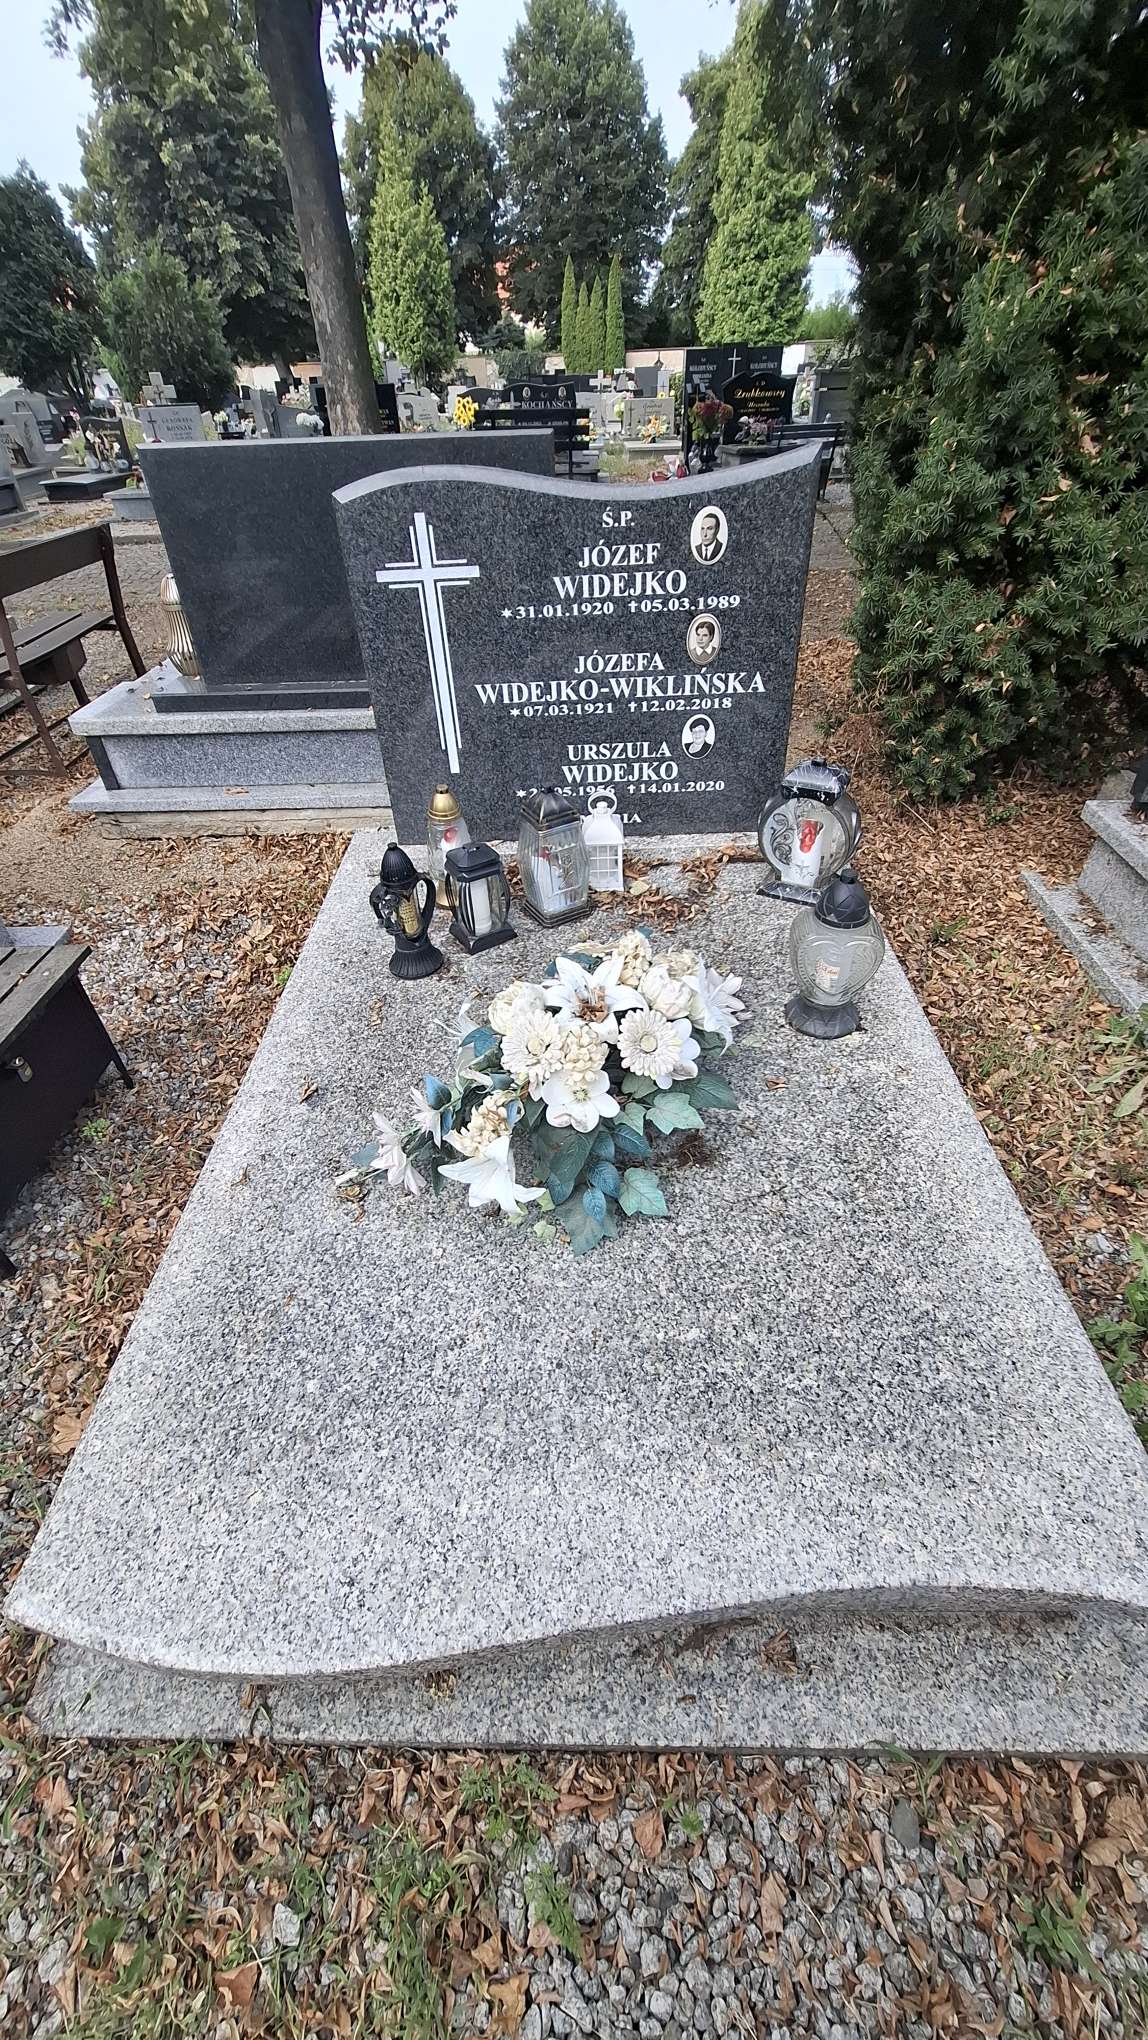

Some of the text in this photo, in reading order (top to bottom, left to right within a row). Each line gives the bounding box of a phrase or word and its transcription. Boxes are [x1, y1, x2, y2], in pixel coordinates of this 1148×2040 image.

[602, 507, 635, 528] Ś.P.
[578, 539, 661, 568] JÓZEF
[552, 569, 688, 600] WIDEJKO
[574, 650, 665, 674] JÓZEFA
[474, 667, 766, 705] WIDEJKO-WIKLIŃSKA
[567, 741, 672, 761] URSZULA
[561, 761, 679, 784] WIDEJKO
